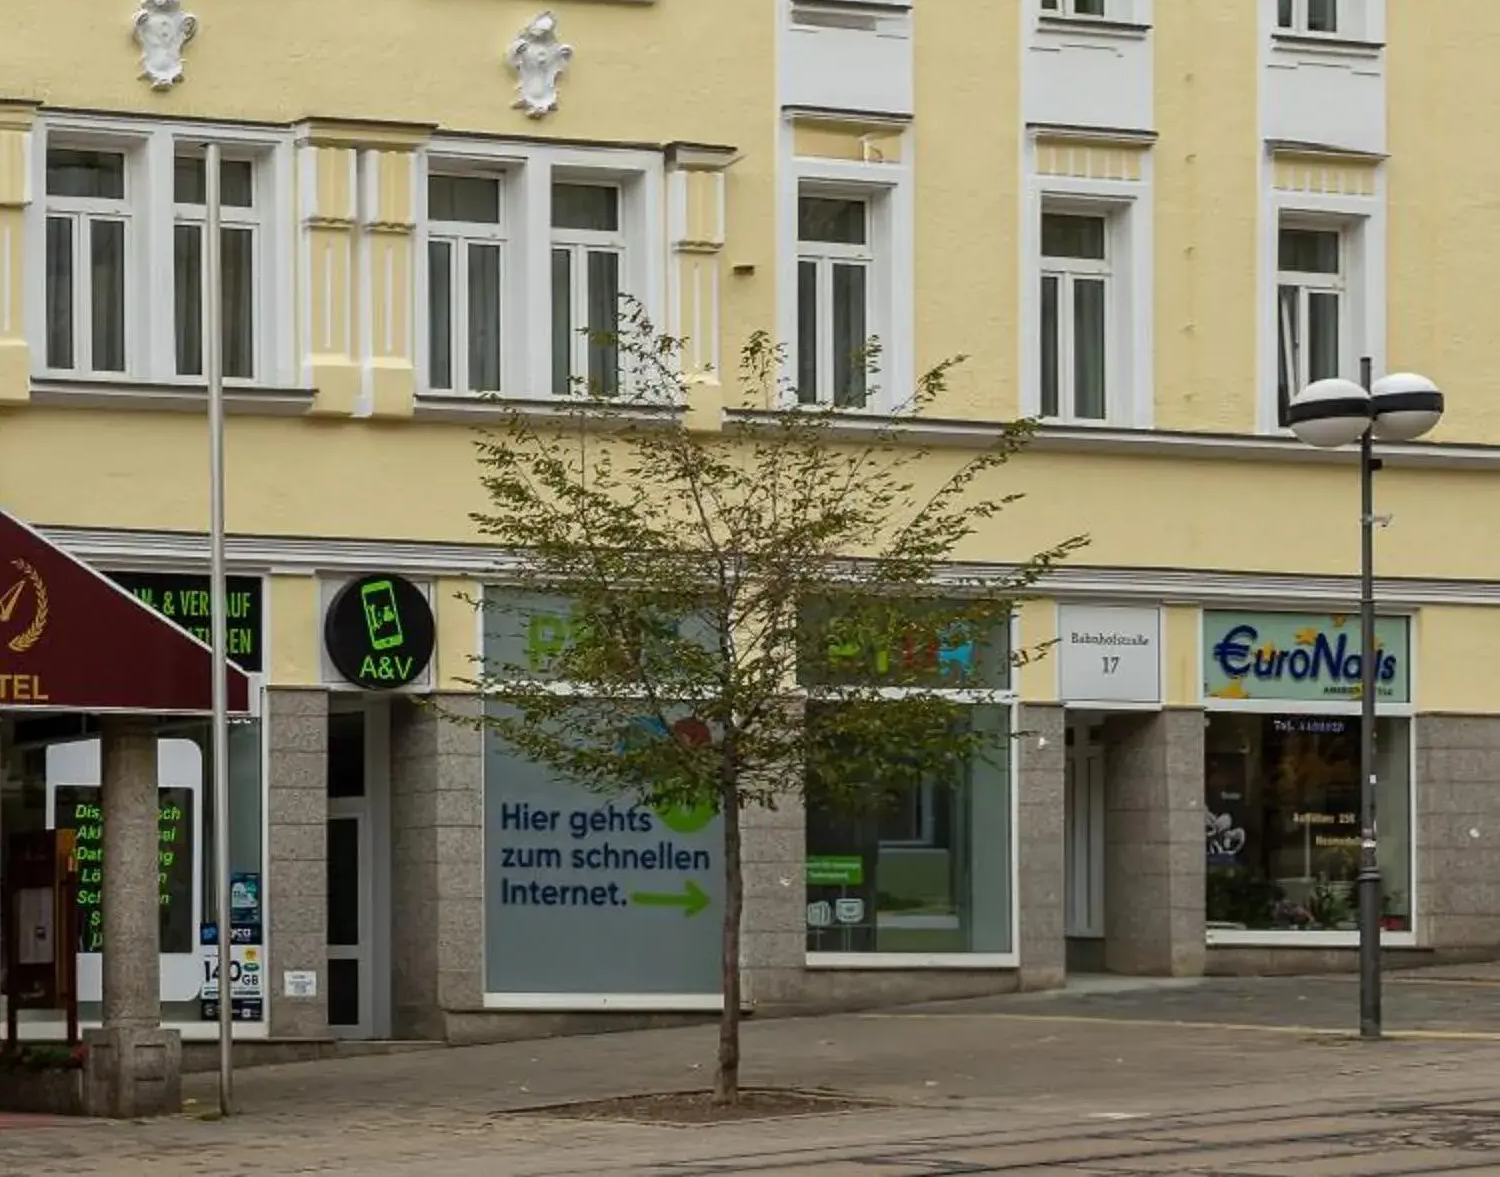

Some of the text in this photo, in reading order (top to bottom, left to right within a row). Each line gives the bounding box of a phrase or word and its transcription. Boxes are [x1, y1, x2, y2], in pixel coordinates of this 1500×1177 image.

[359, 655, 413, 680] A&V
[1102, 656, 1120, 674] 17
[502, 803, 653, 838] Hier gehts
[502, 842, 710, 869] zum schnellen
[502, 878, 627, 906] Internet.
[242, 974, 259, 985] GB
